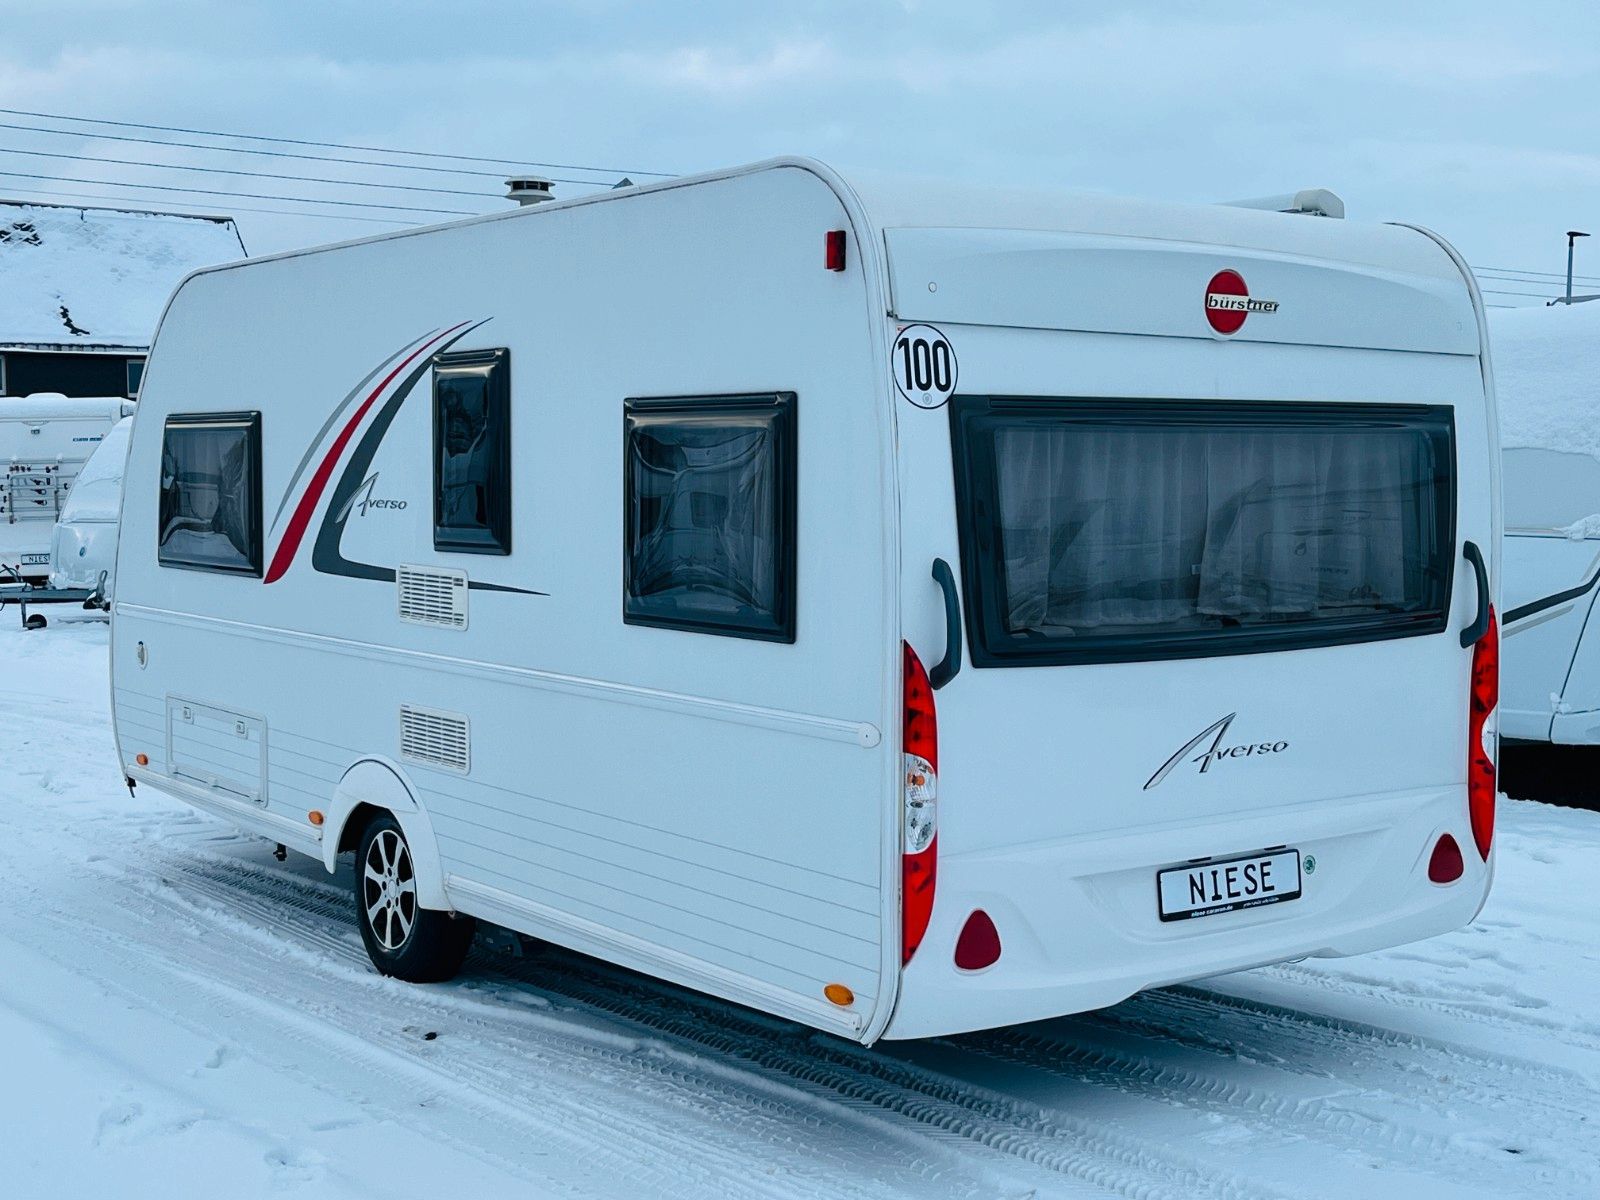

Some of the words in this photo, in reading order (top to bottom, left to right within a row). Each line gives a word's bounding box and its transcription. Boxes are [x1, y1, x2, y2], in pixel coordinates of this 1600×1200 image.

[1208, 295, 1280, 312] bürstner
[898, 337, 951, 392] 100
[335, 471, 408, 524] Averso
[29, 555, 49, 563] NIES
[1143, 711, 1289, 791] Averso
[1189, 861, 1275, 905] NIESE
